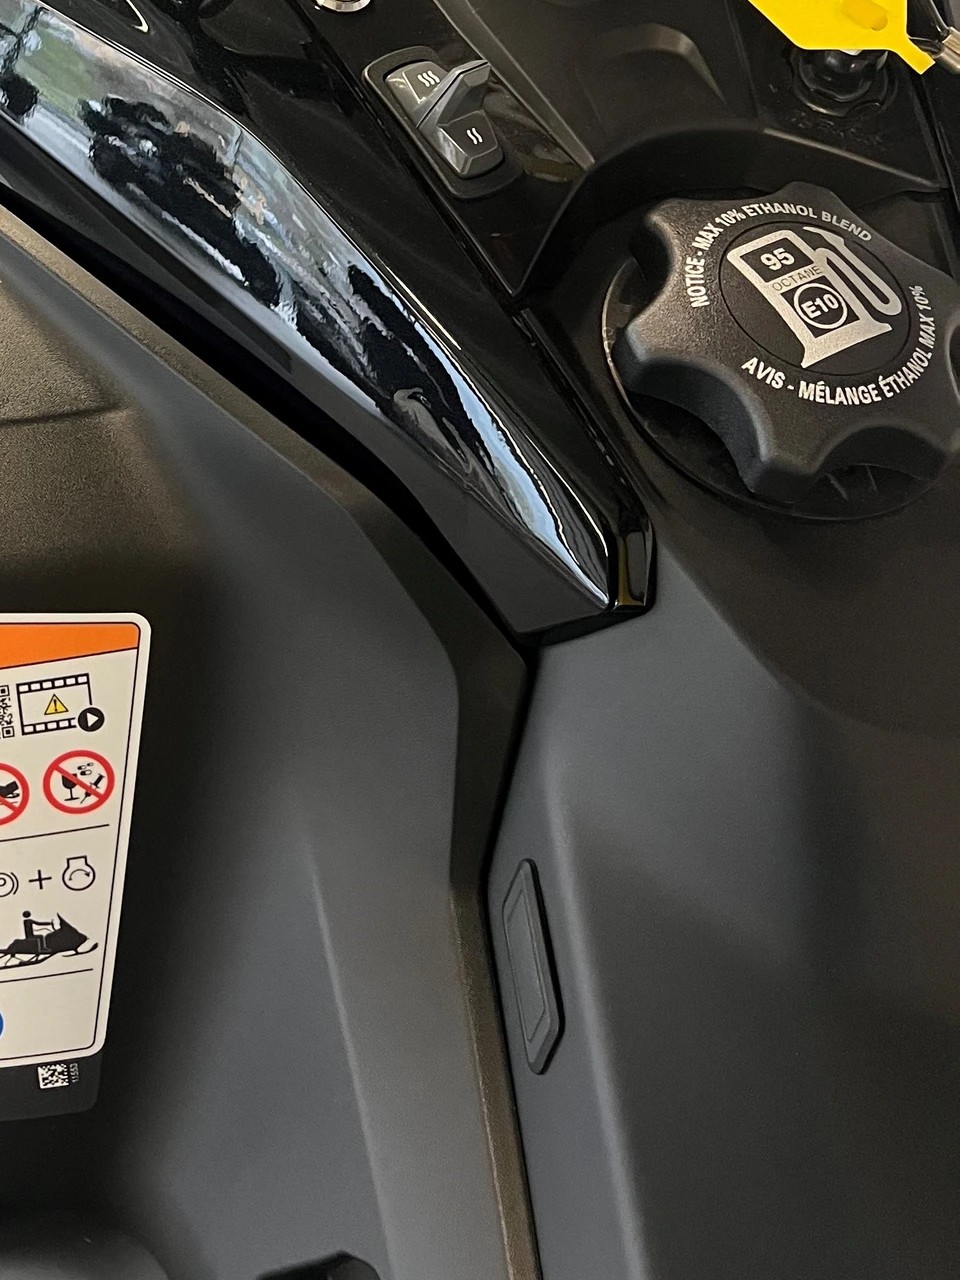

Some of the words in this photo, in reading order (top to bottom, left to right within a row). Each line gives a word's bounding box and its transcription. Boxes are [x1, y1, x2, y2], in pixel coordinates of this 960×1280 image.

[715, 208, 747, 230] 10%
[742, 202, 818, 220] ETHANOL
[693, 221, 724, 252] MAX
[821, 210, 872, 242] BLEND
[759, 247, 796, 271] 95
[685, 257, 710, 308] NOTICE
[771, 264, 822, 292] OCTANE
[801, 293, 840, 319] E10
[908, 284, 933, 312] 10%
[918, 314, 936, 349] MAX
[741, 356, 786, 390] AVIS
[879, 346, 934, 399] ÉTHANOL
[798, 380, 882, 406] MÉLANGE
